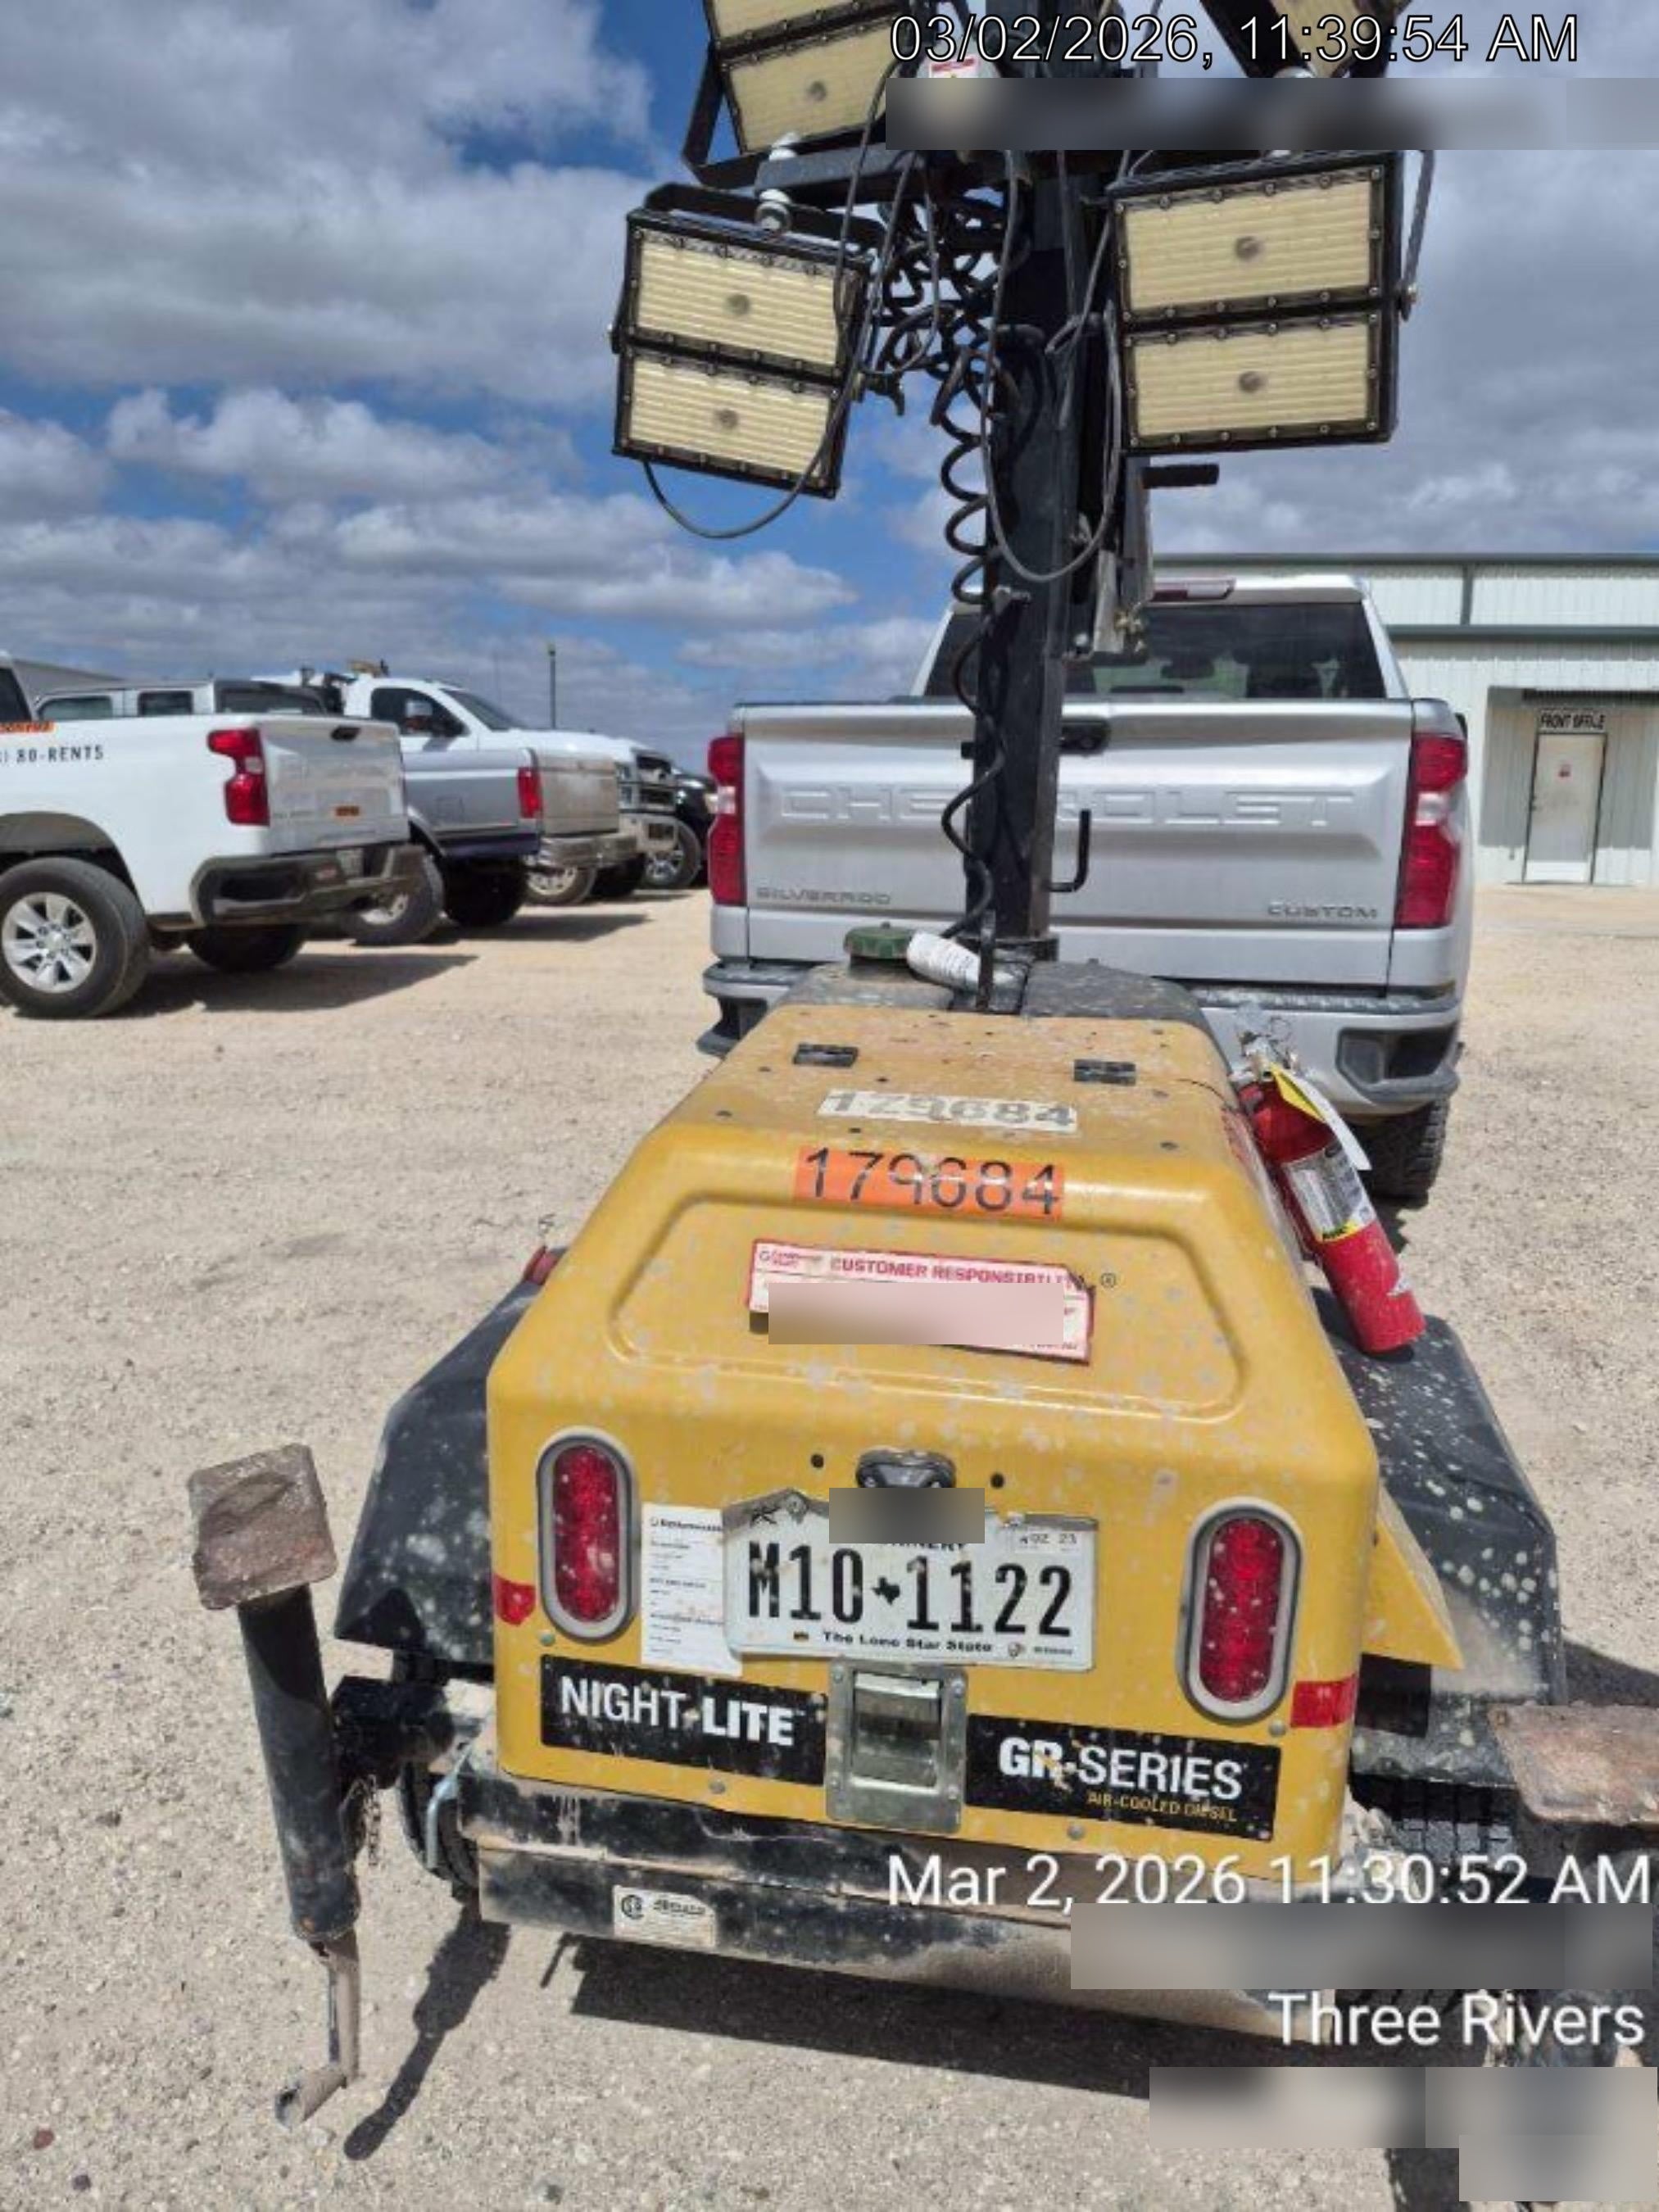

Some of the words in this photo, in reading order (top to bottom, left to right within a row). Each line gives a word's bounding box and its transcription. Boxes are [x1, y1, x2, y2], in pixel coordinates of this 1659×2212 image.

[1541, 714, 1571, 728] FRONT
[755, 886, 892, 905] SILVERADO
[1267, 901, 1378, 920] CUSTOM
[827, 1090, 1075, 1128] 179684
[805, 1145, 1061, 1216] 179684
[830, 1257, 928, 1279] CUSTOMER
[823, 1630, 854, 1643] The
[859, 1633, 900, 1648] Lone
[905, 1637, 941, 1650] Star
[945, 1640, 993, 1653] State
[1086, 1792, 1180, 1815] AIR-COOLED
[1184, 1802, 1239, 1822] DIESEL
